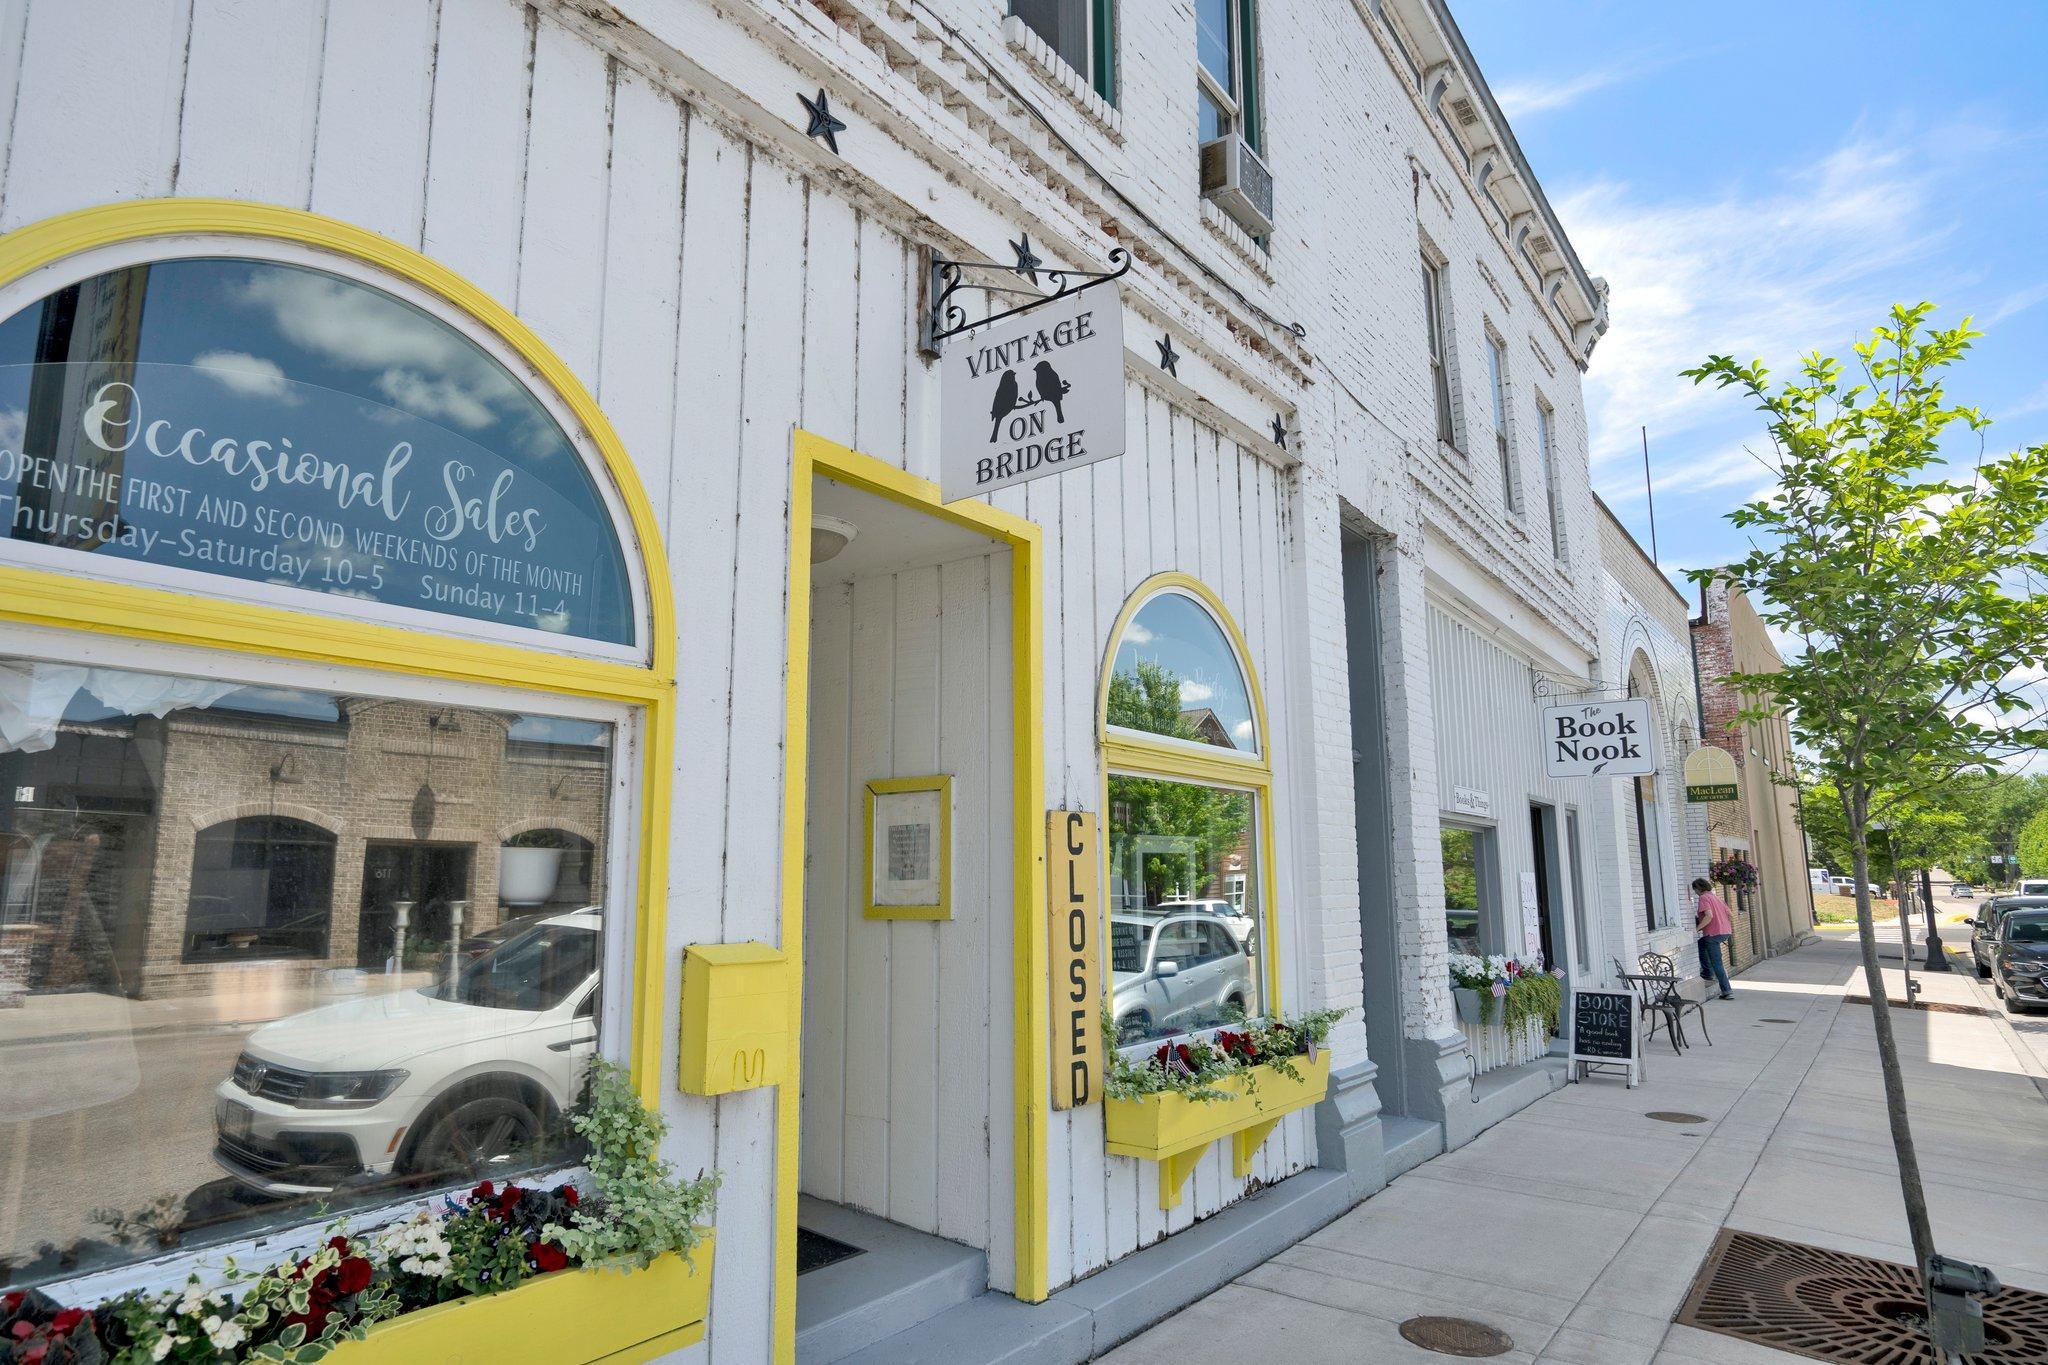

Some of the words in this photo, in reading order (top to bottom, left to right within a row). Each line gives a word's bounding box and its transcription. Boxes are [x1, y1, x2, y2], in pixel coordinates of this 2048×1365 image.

[966, 311, 1096, 379] VINTAGE
[1009, 410, 1046, 441] ON
[84, 382, 411, 521] Occasional
[424, 460, 547, 552] Sales
[975, 429, 1088, 485] BRIDGE
[0, 449, 69, 493] OPEN
[74, 464, 121, 504] THE
[126, 477, 191, 517] FIRST
[196, 494, 247, 528] AND
[254, 506, 345, 549] SECOND
[356, 528, 458, 571] WEEKENDS
[465, 550, 489, 577] OF
[492, 555, 522, 585] THE
[525, 563, 583, 597] MONTH
[321, 556, 385, 590] 10-5
[420, 574, 505, 616] Sunday
[514, 592, 566, 621] 11-4
[1555, 712, 1637, 739] Book
[1580, 706, 1602, 720] The
[1555, 736, 1641, 763] Nook
[1690, 786, 1734, 796] MacLean
[1066, 812, 1089, 1108] CLOSED
[1578, 993, 1630, 1013] BOOK
[1577, 1010, 1630, 1028] STORE
